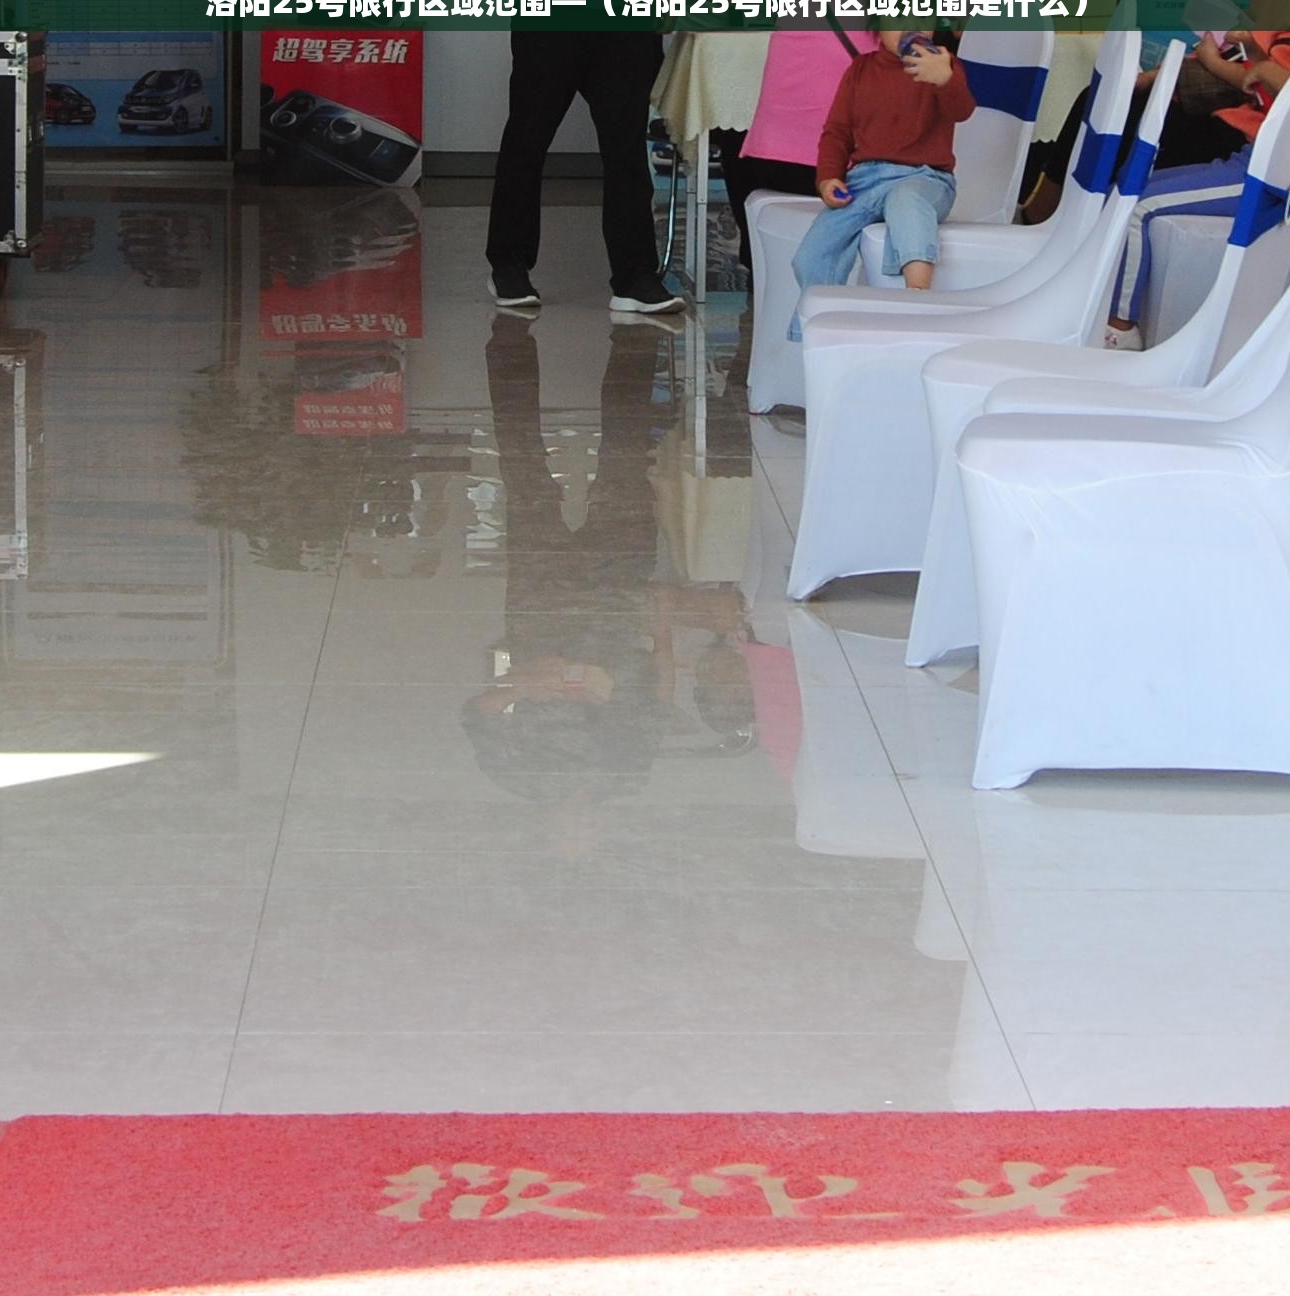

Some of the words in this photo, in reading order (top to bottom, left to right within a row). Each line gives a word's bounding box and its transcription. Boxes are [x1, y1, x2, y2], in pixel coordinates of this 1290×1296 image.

[272, 37, 410, 65] 超驾享系统
